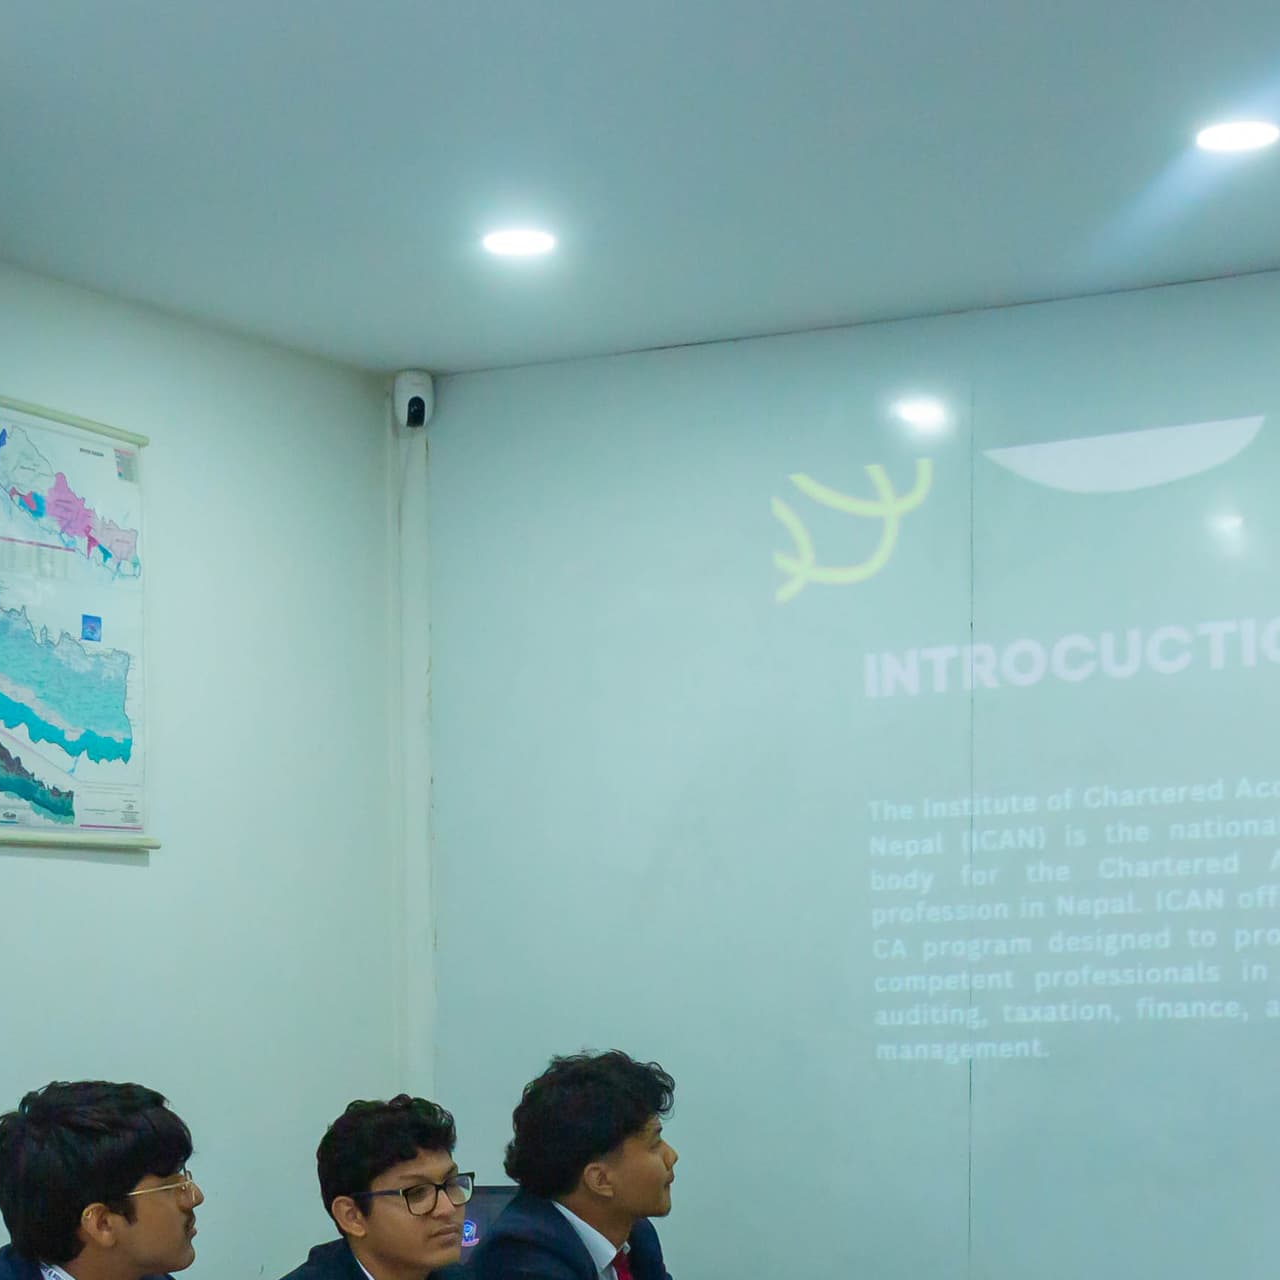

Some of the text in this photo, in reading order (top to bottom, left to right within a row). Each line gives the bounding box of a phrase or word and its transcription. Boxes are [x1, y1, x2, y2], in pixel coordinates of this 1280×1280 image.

[869, 801, 911, 821] The
[923, 796, 1036, 819] Institute
[1047, 788, 1072, 811] of
[1082, 777, 1223, 809] Chartered
[870, 832, 942, 860] Nepal
[961, 826, 1045, 855] (ICAN)
[1065, 825, 1085, 846] is
[1105, 821, 1149, 843] the
[871, 870, 933, 894] body
[961, 864, 998, 886] for
[1026, 860, 1070, 883] the
[1099, 851, 1238, 879] Chartered
[872, 901, 1007, 929] profession
[1021, 895, 1044, 918] in
[1155, 888, 1223, 911] ICAN
[872, 938, 906, 960] CA
[923, 936, 1031, 964] program
[1048, 927, 1169, 957] designed
[1187, 928, 1215, 947] to
[874, 969, 1014, 997] competent
[1034, 959, 1219, 992] professionals
[1242, 957, 1266, 982] in
[1002, 1003, 1120, 1023] taxation,
[1136, 994, 1248, 1022] finance,
[875, 1037, 1050, 1064] management.
